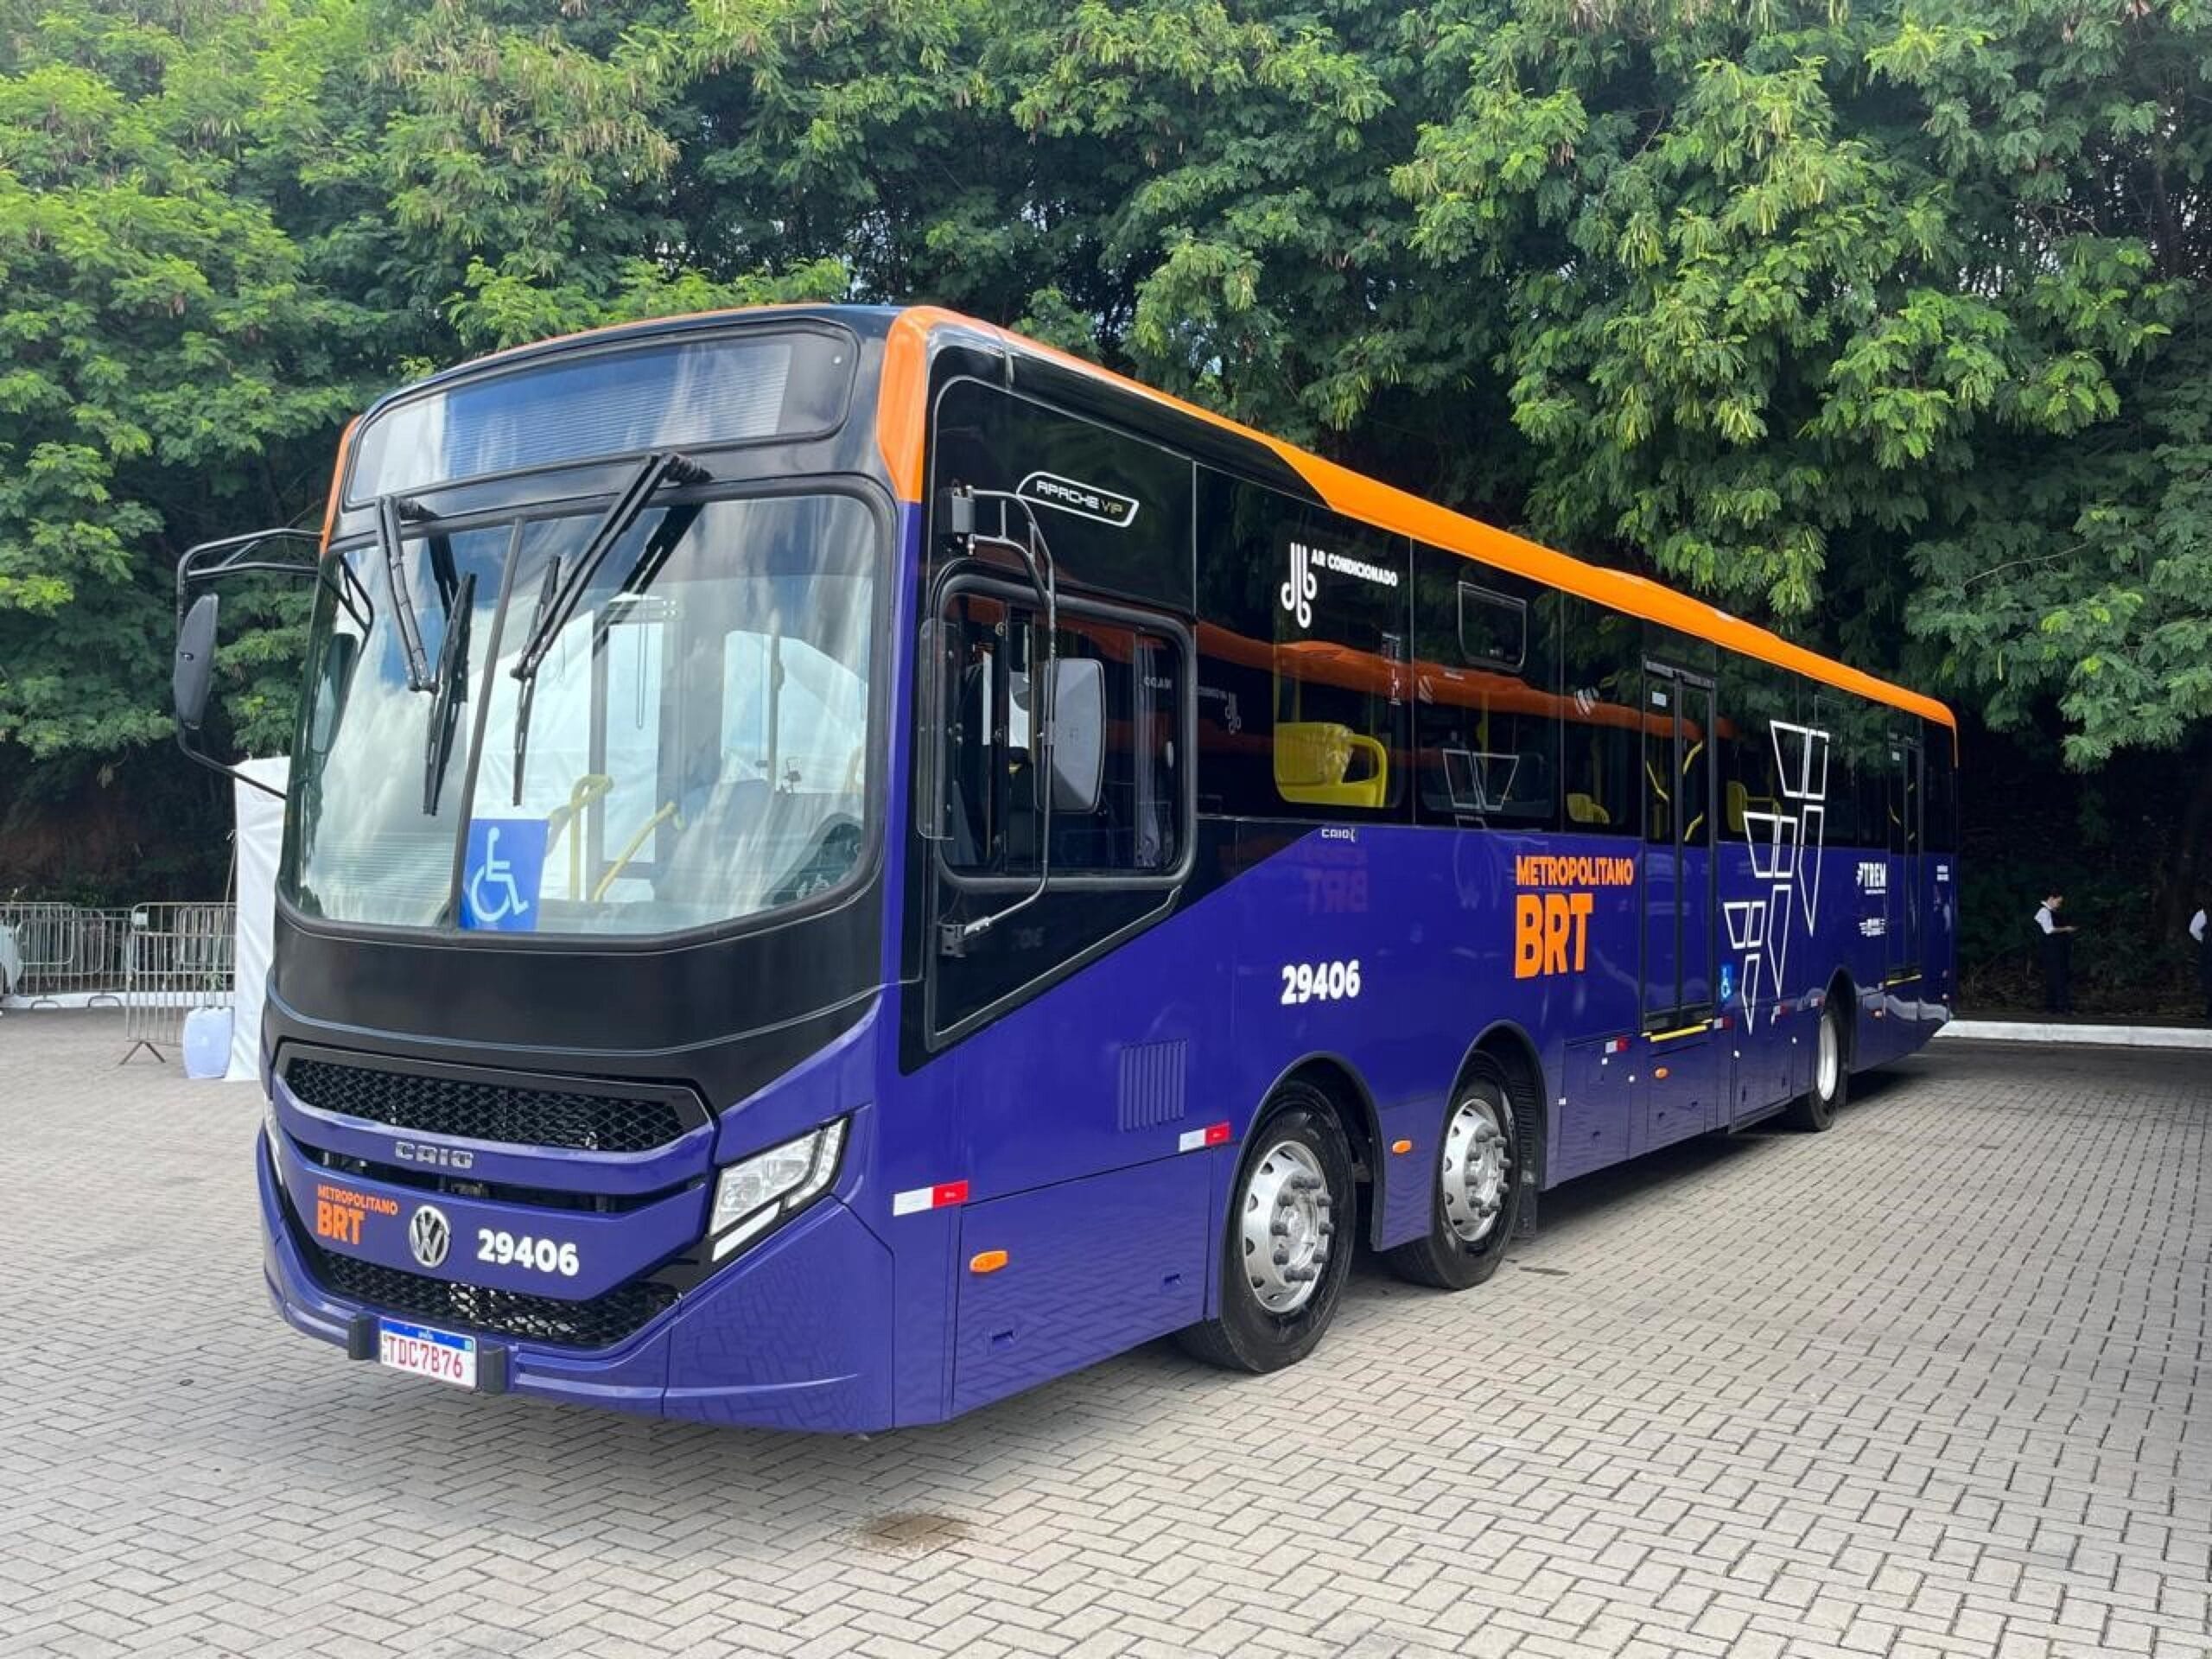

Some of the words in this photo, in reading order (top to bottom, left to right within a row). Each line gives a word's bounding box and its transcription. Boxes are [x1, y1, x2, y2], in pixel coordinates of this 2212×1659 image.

[1036, 480, 1099, 510] APACHE
[1328, 553, 1398, 587] CONDICIONADO
[1321, 829, 1349, 839] CAIO
[1516, 855, 1634, 886] METROPOLITANO
[1515, 893, 1593, 979] BRT
[1281, 960, 1360, 1004] 29406
[317, 1185, 398, 1216] METROPOLITANO
[317, 1200, 365, 1244] BRT
[477, 1228, 579, 1276] 29406
[387, 1335, 463, 1379] TDC7B76
